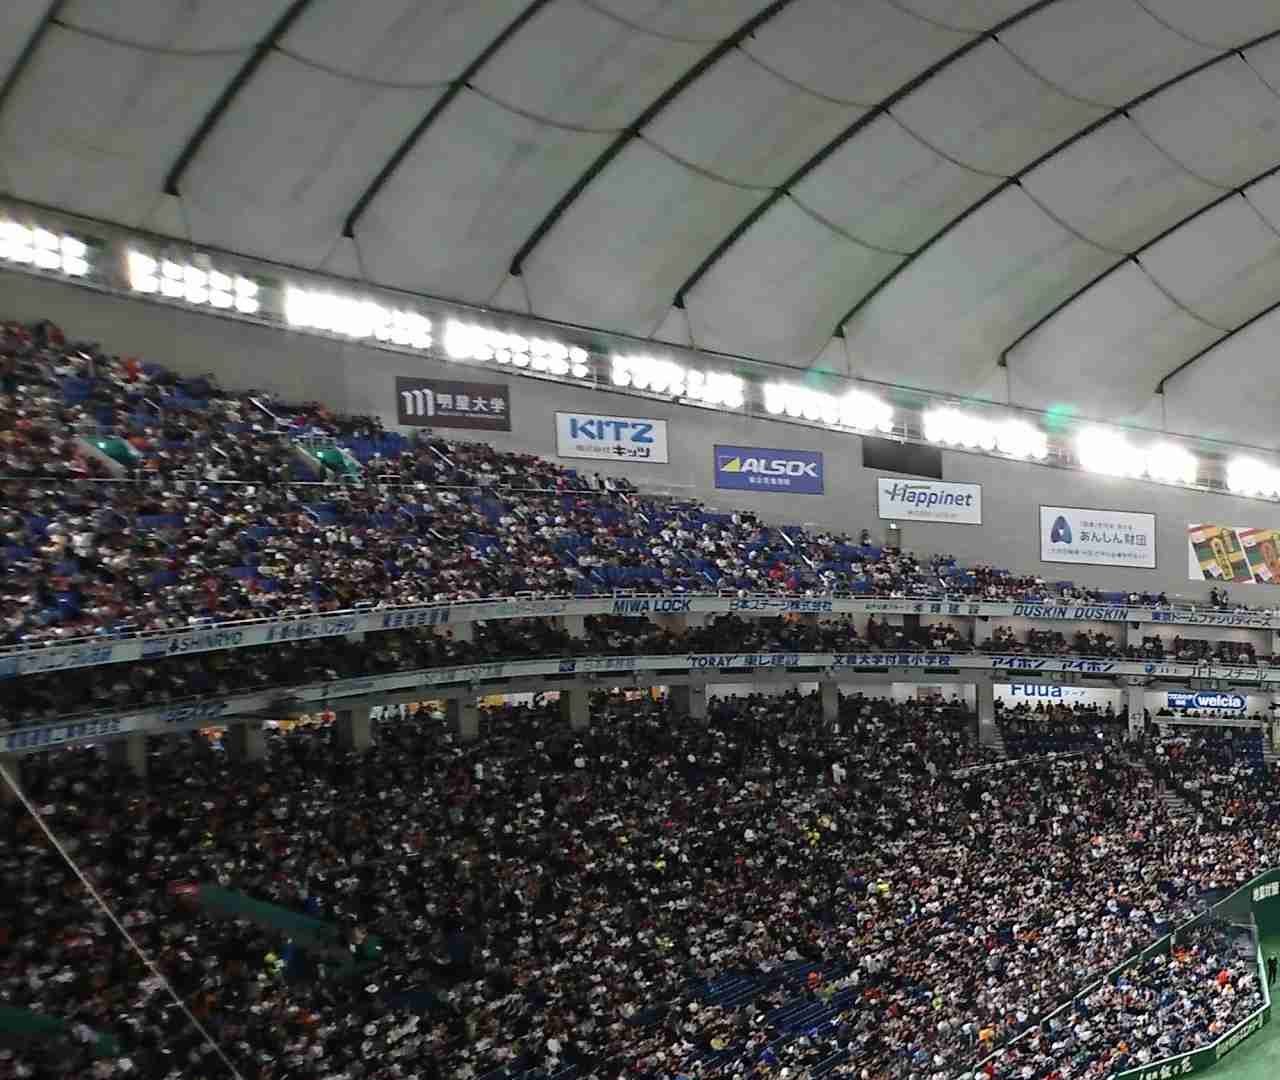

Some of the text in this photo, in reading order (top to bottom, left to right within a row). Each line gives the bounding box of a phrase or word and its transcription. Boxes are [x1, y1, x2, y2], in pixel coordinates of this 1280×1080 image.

[569, 417, 654, 443] KITZ
[741, 458, 820, 478] ALSOK
[884, 482, 973, 508] Happinet
[1079, 530, 1148, 547] あんしん財団
[612, 599, 691, 613] MIWA LOCK
[1012, 604, 1130, 620] DUSKIN DUSKIN
[991, 657, 1047, 669] アイホン
[1060, 659, 1115, 672] アイホン
[1196, 694, 1243, 709] welcia
